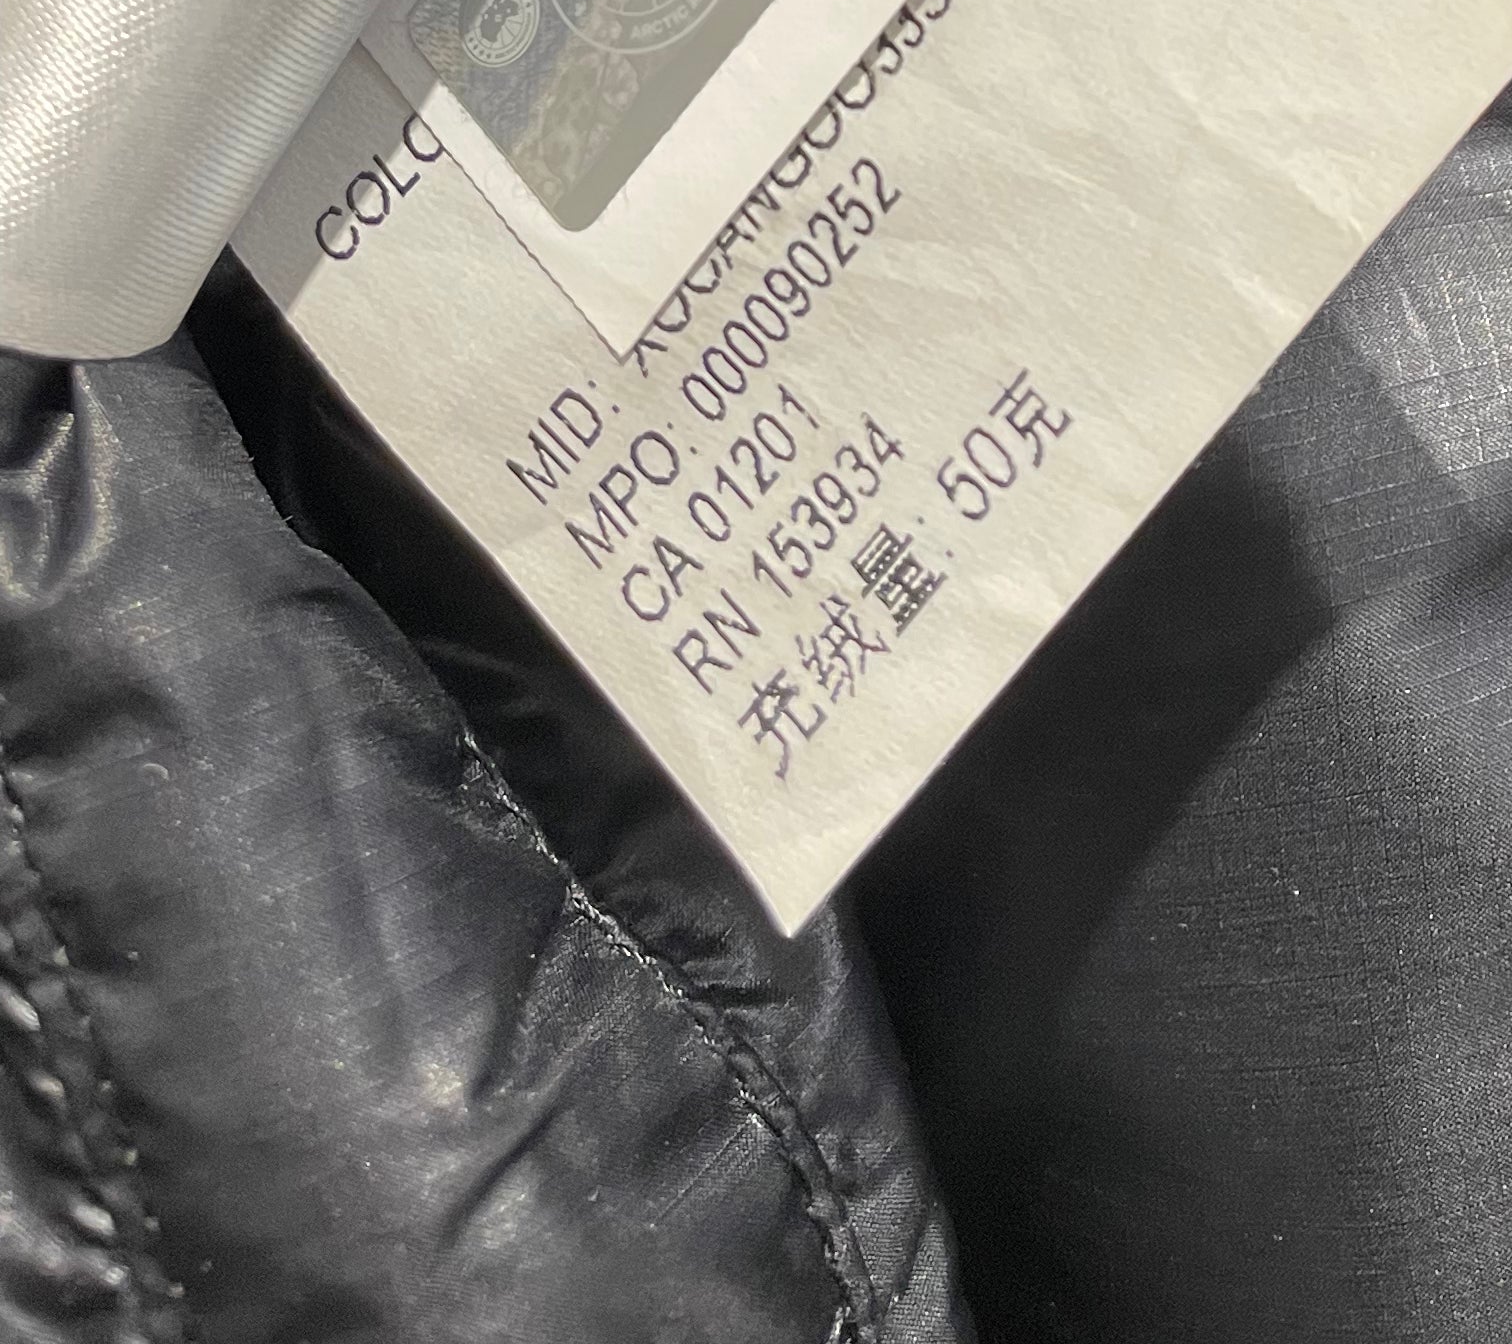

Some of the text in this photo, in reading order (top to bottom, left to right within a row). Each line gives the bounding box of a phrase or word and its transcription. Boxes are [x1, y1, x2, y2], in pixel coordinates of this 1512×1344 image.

[629, 5, 689, 39] ARCTIC
[506, 379, 620, 505] MID:
[564, 158, 901, 570] MPO: 000090252
[621, 384, 820, 622] CA 01201
[673, 412, 904, 695] RN 153934
